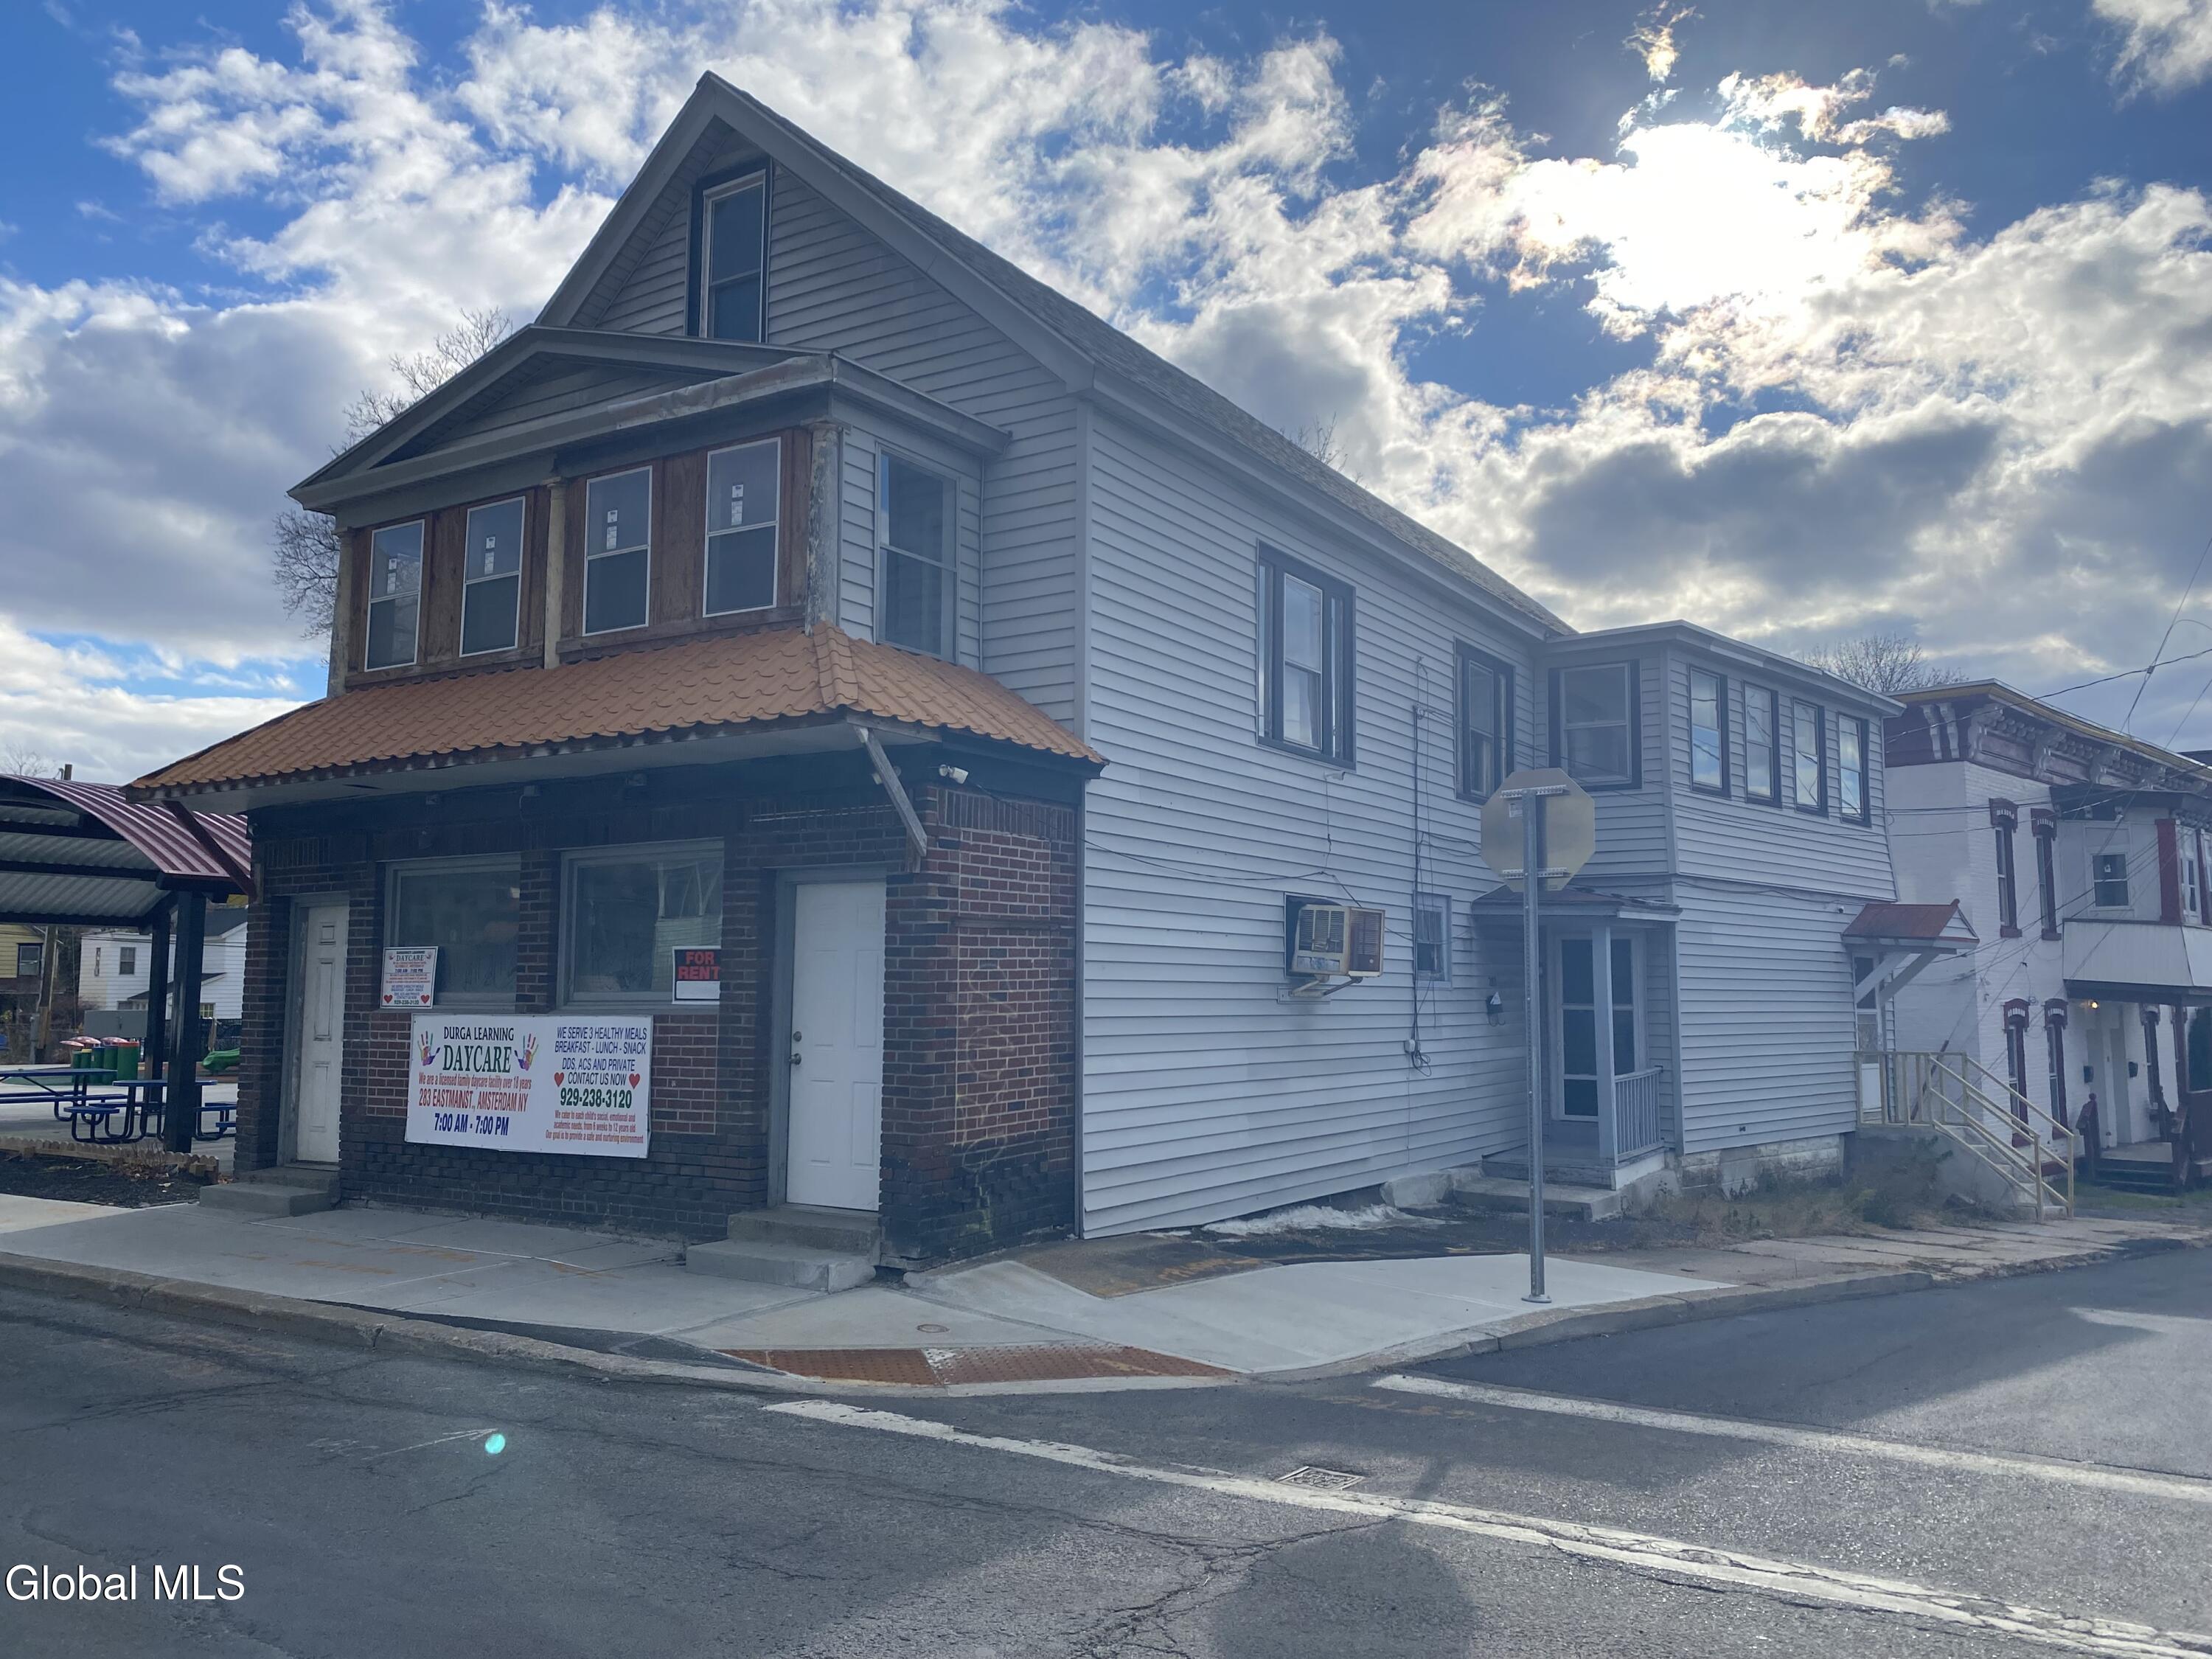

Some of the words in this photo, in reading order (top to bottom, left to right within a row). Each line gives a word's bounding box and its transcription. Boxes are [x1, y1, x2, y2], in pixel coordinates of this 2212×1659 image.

[686, 951, 714, 964] FOR
[678, 967, 720, 979] RENT
[444, 1026, 471, 1040] DURGA
[474, 1027, 514, 1041] LEARNING
[557, 1027, 567, 1038] WE
[568, 1027, 588, 1039] SERVE
[589, 1027, 593, 1039] 3
[594, 1027, 624, 1040] HEALTHY
[625, 1028, 647, 1040] MEALS
[555, 1041, 591, 1053] BREAKFAST
[596, 1042, 618, 1054] LUNCH
[624, 1042, 646, 1054] SNACK
[442, 1045, 512, 1073] DAYCARE
[578, 1058, 591, 1070] ACS
[593, 1059, 606, 1071] AND
[608, 1059, 635, 1071] PRIVATE
[419, 1072, 426, 1085] We
[435, 1077, 437, 1085] a
[471, 1074, 487, 1089] daycare
[489, 1075, 502, 1090] facility
[503, 1078, 512, 1088] over
[519, 1079, 532, 1091] years
[568, 1072, 599, 1085] CONTACT
[599, 1073, 609, 1085] US
[611, 1074, 627, 1085] NOW
[419, 1088, 431, 1106] 283
[477, 1091, 516, 1111] AMSTERDAM
[518, 1093, 528, 1112] NY
[560, 1088, 632, 1108] 929-238-3120
[435, 1113, 452, 1132] 7:00
[454, 1114, 468, 1133] AM
[476, 1116, 493, 1135] 7:00
[495, 1117, 509, 1135] PM
[613, 1123, 618, 1132] 12
